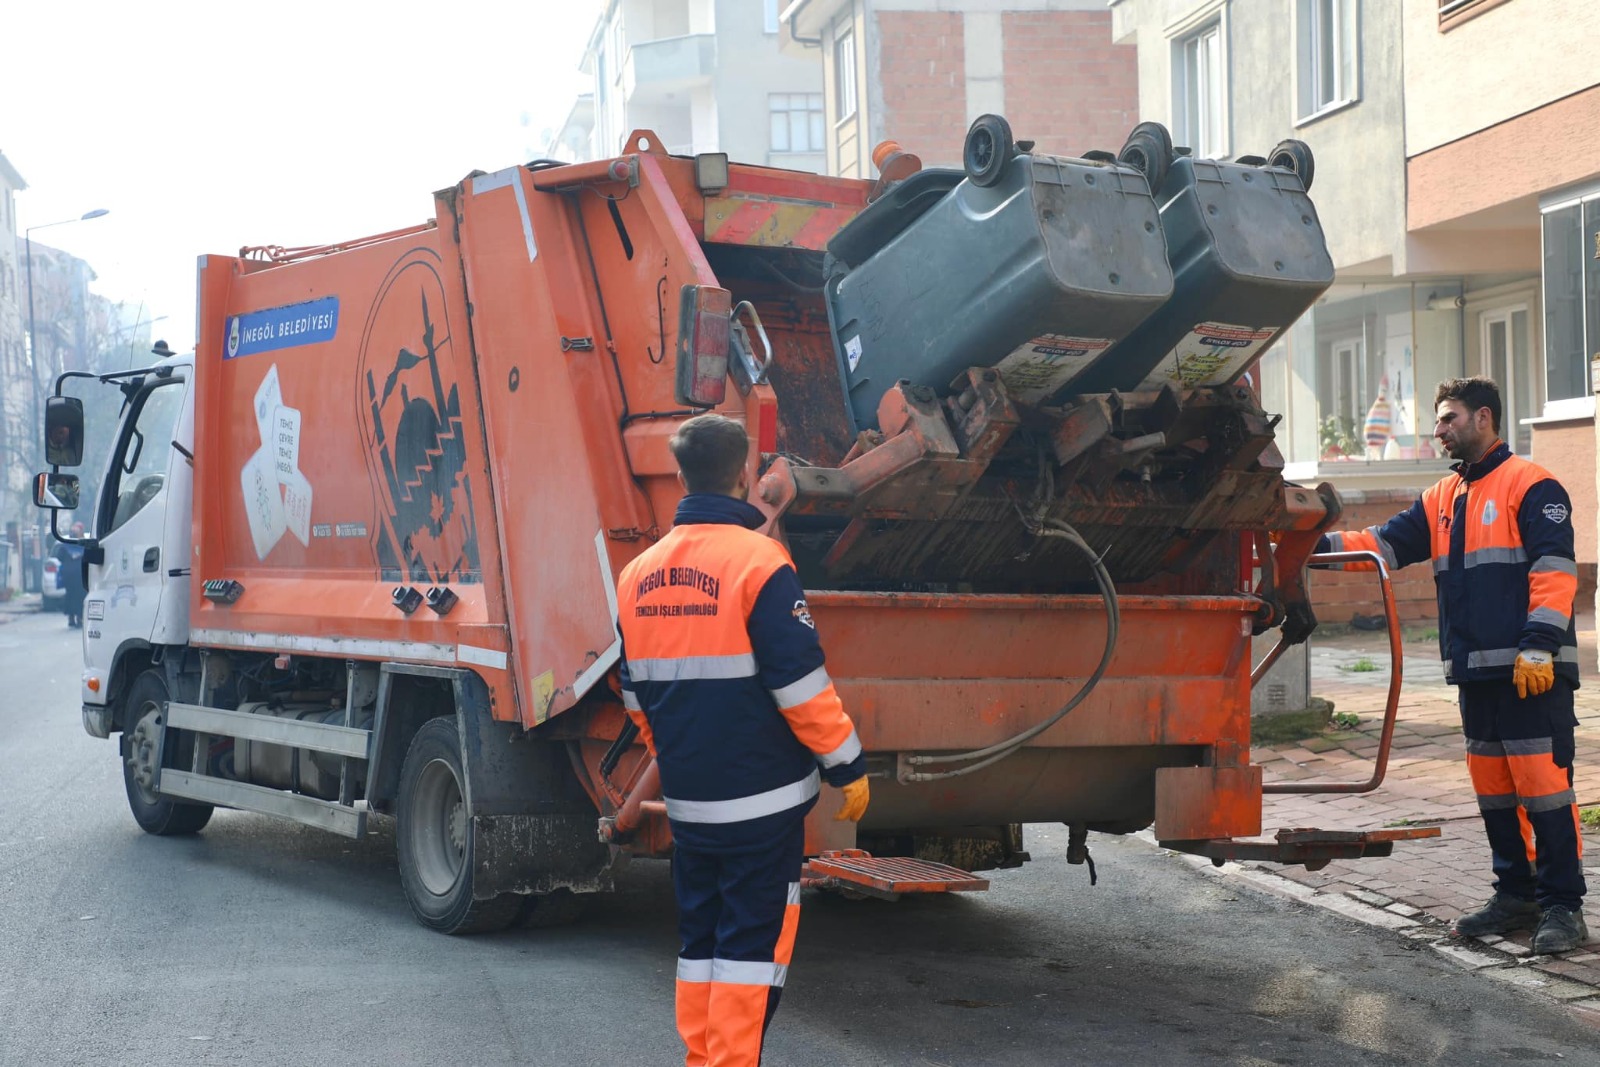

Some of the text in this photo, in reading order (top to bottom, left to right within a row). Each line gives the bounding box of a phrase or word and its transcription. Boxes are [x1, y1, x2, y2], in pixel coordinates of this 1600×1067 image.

[242, 310, 334, 345] İNEGÖL BELEDİYESİ
[280, 418, 293, 430] TEMİZ
[279, 432, 294, 445] ÇEVRE
[669, 565, 720, 601] BELEDİYESİ
[659, 603, 682, 618] İŞLERİ
